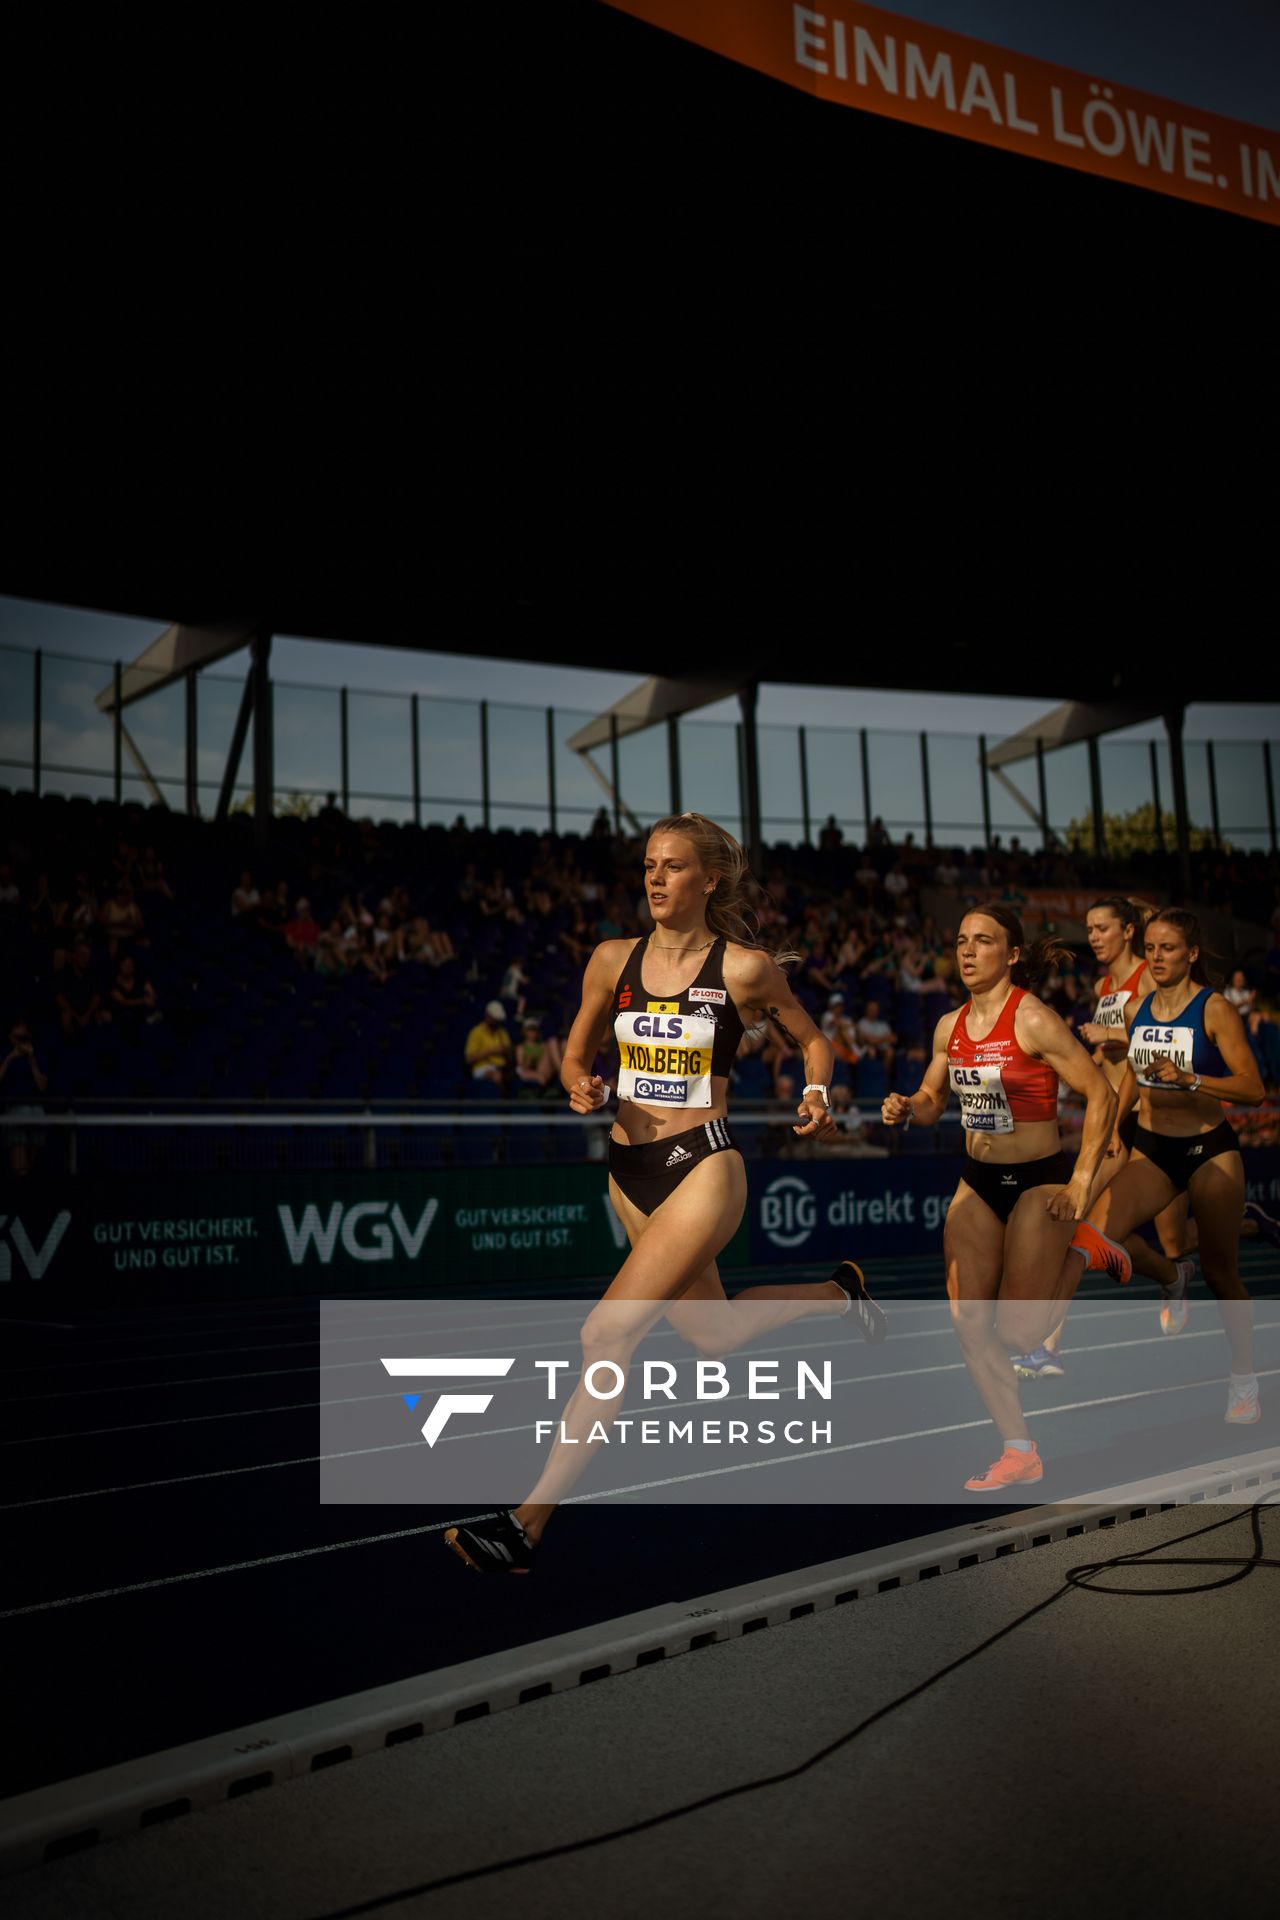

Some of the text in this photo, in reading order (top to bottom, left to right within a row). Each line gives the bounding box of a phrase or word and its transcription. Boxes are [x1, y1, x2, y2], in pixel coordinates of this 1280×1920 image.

[792, 2, 1039, 136] EINMAL
[1050, 82, 1229, 190] LÖWE.
[701, 991, 723, 999] LOTTO
[626, 1045, 701, 1075] KOLBERG
[1134, 1047, 1185, 1068] WILEM
[654, 1083, 685, 1095] PLAN
[665, 1151, 692, 1167] adidas
[454, 1207, 487, 1230] GUT
[489, 1203, 588, 1228] VERSICHERT.
[827, 1191, 915, 1227] direkt
[94, 1216, 259, 1244] GUT VERSICHERT.
[277, 1197, 439, 1264] WGV
[471, 1229, 574, 1251] UND GUT IST.
[0, 1208, 73, 1283] V
[113, 1244, 240, 1271] UND GUT IST.
